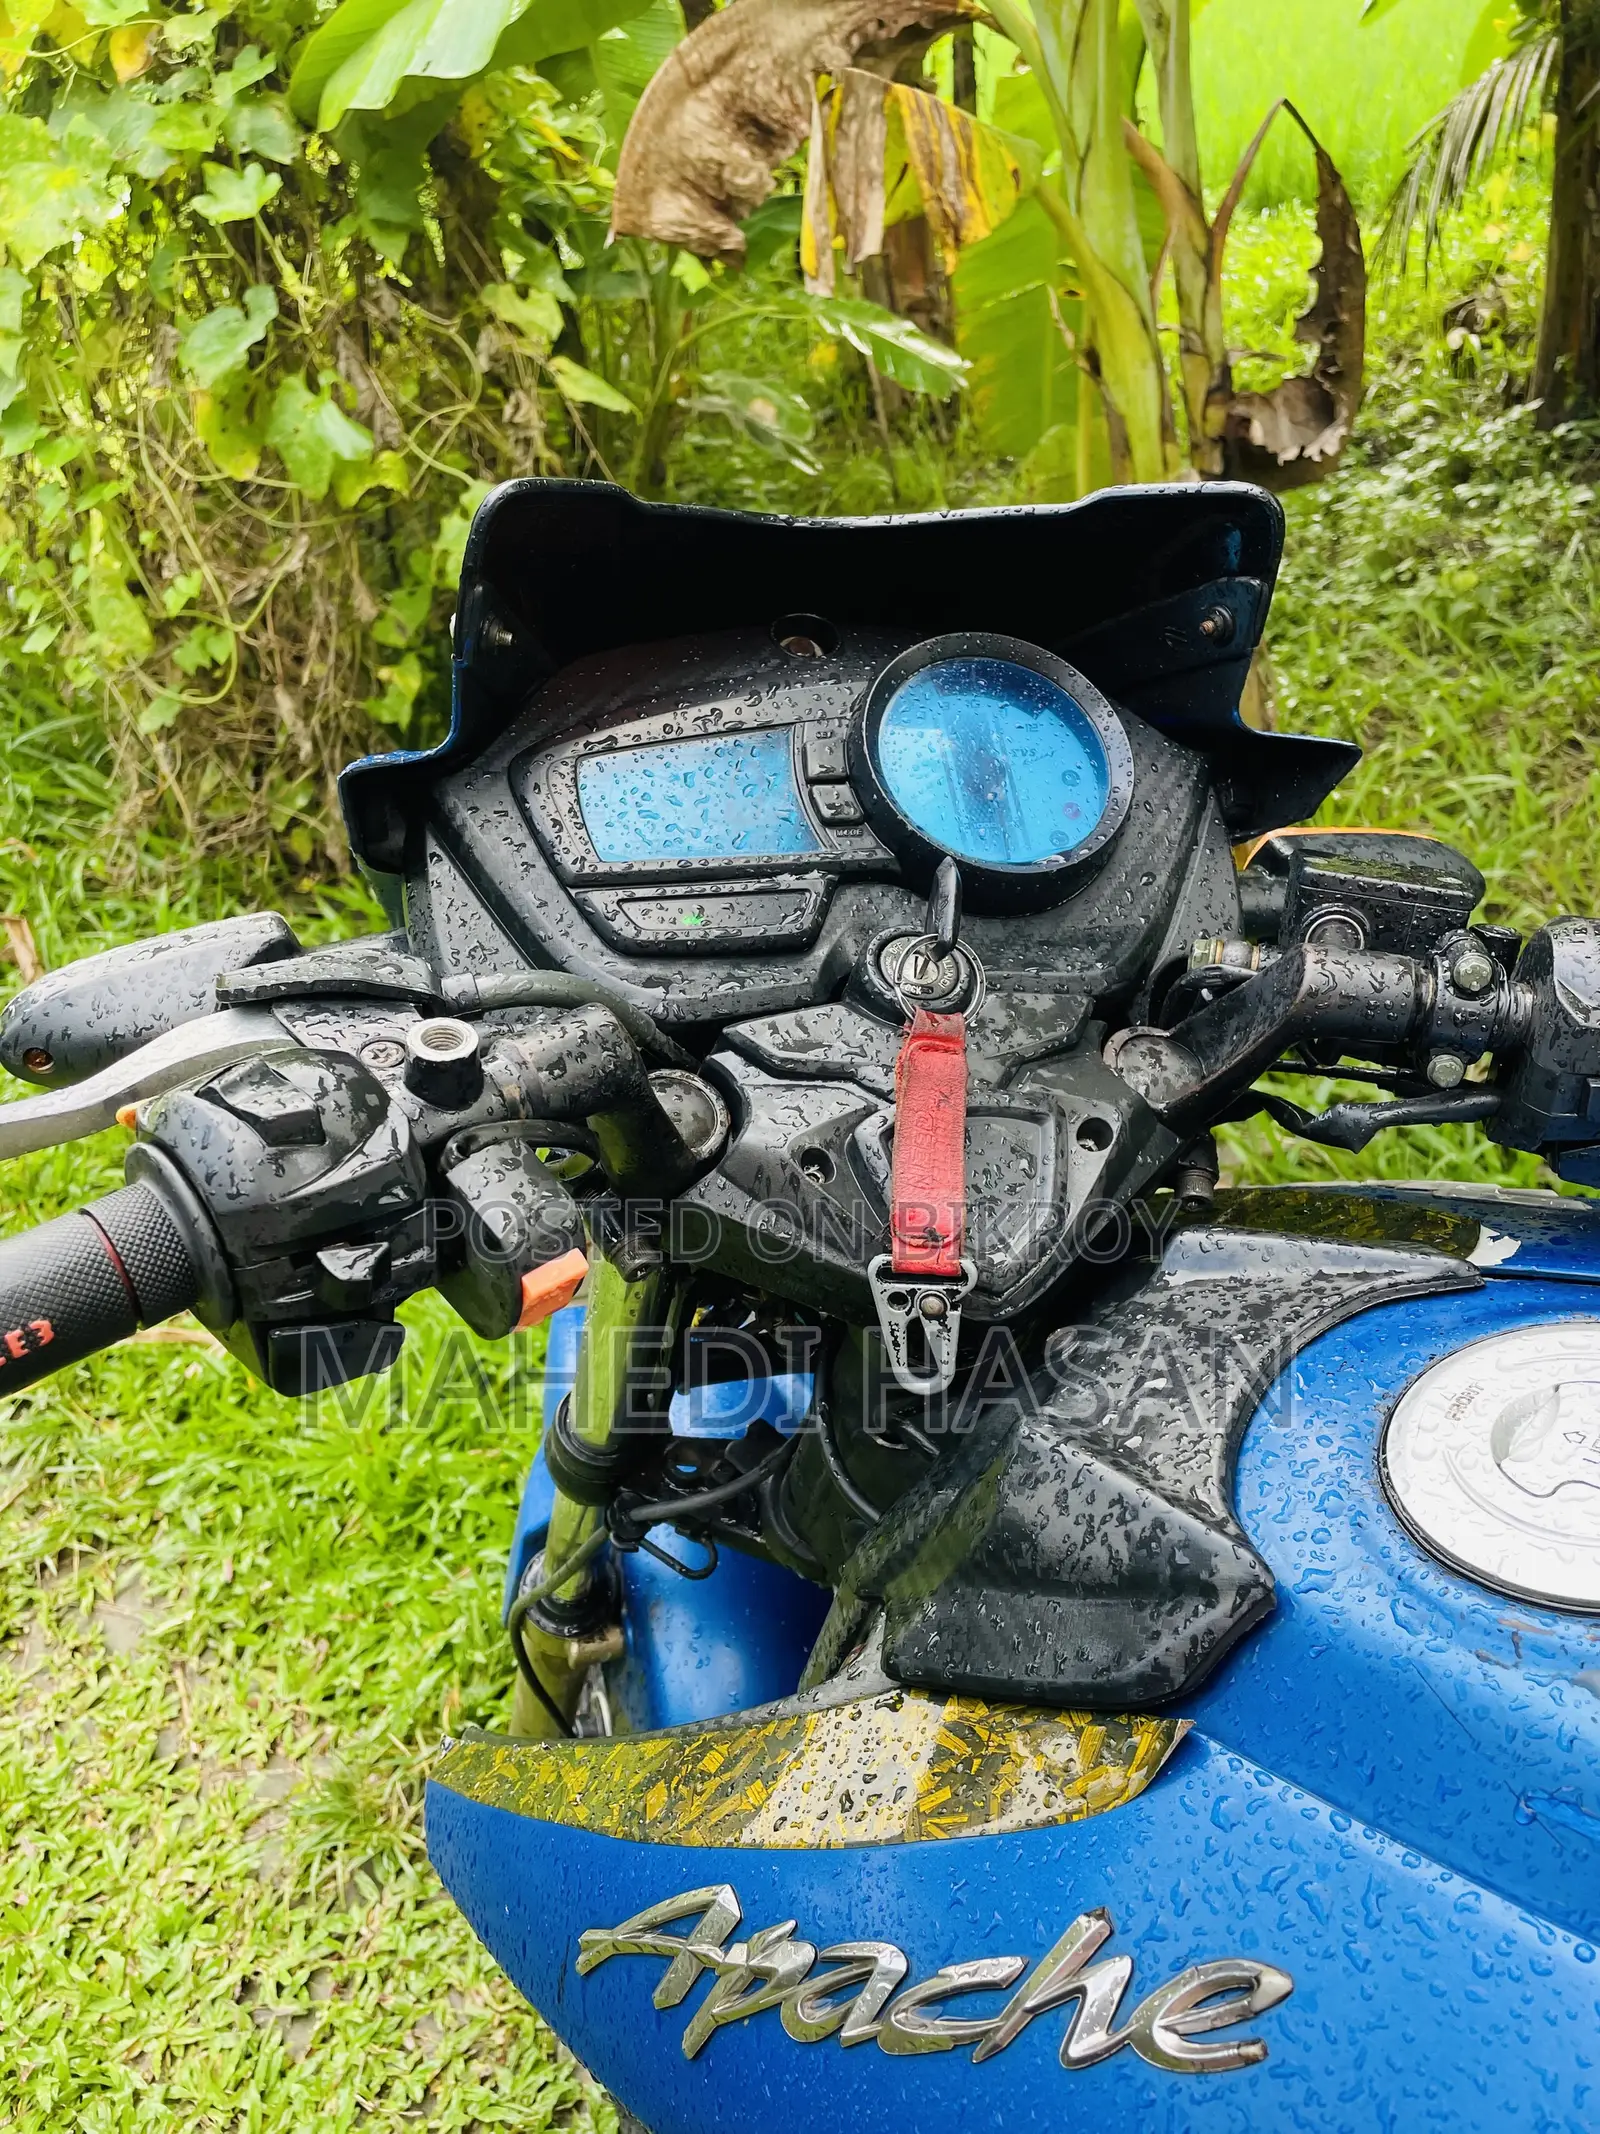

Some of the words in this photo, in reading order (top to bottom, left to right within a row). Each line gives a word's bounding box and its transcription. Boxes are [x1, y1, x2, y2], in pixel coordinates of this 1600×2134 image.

[836, 828, 863, 837] MODE
[890, 942, 903, 954] OFF
[575, 1883, 1295, 2074] Apache
